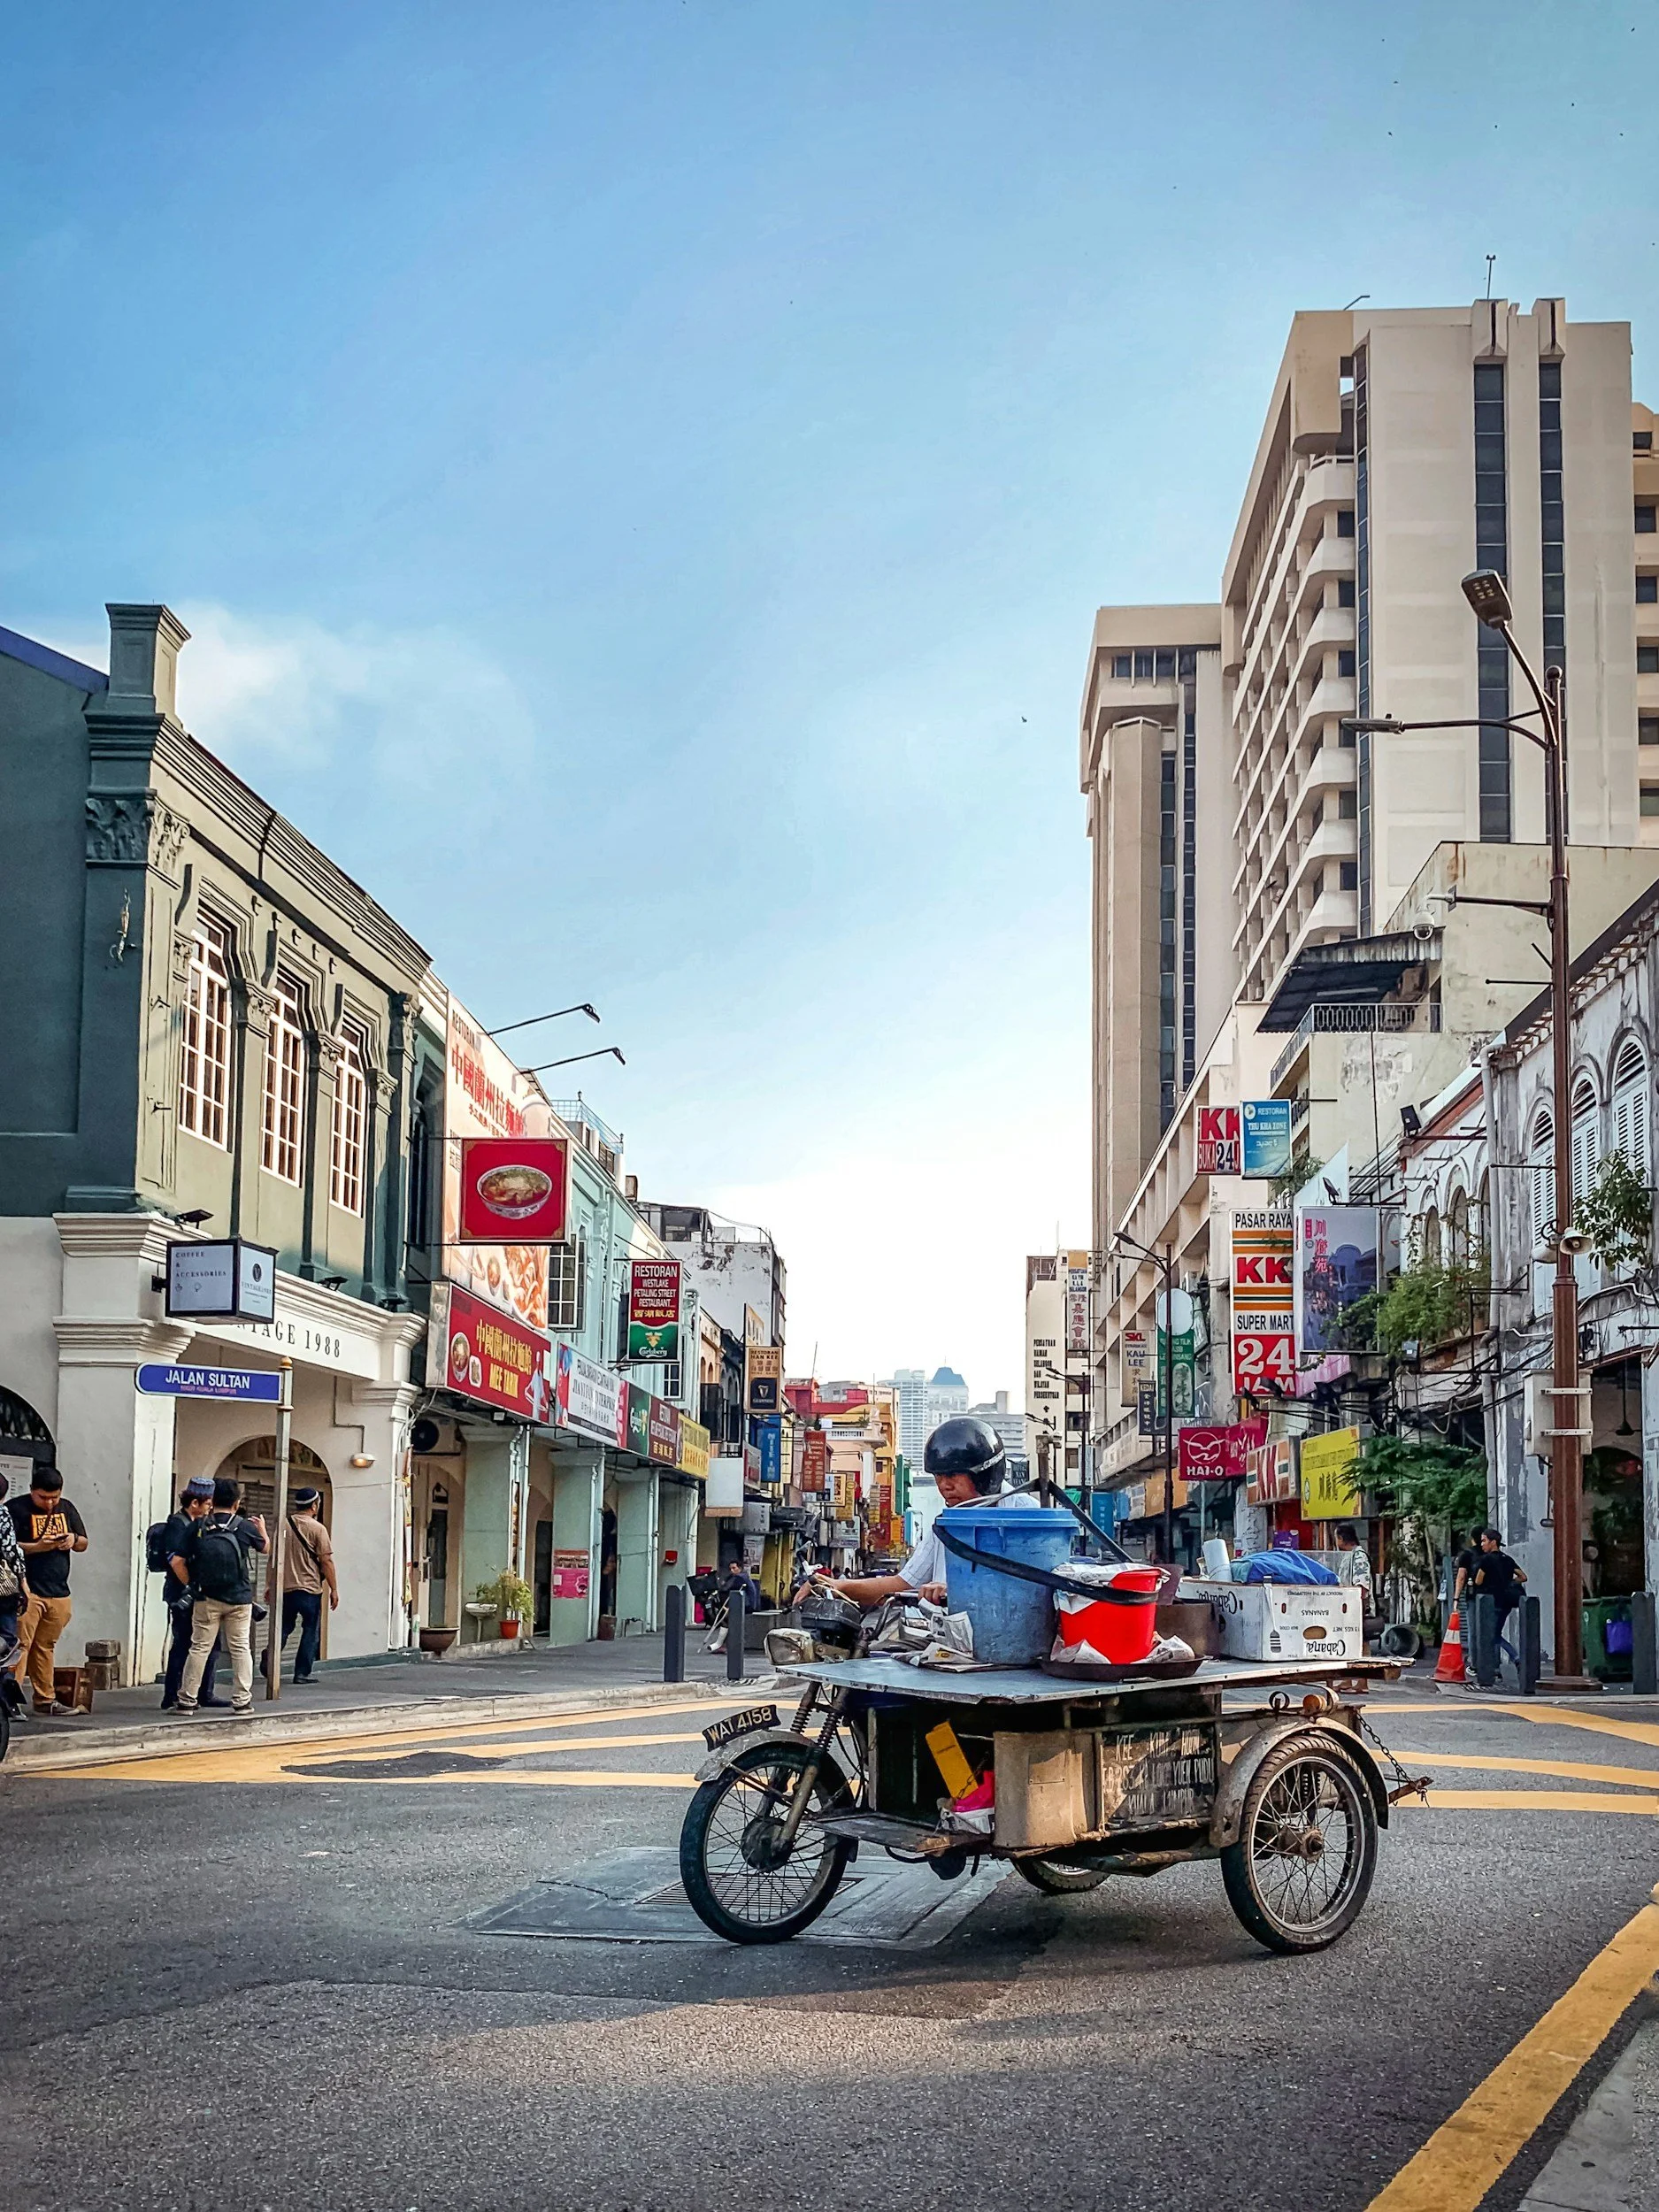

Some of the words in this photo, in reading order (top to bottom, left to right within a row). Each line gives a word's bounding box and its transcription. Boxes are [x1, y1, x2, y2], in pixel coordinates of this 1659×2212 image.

[1257, 1107, 1287, 1116] RESTORAN
[1199, 1143, 1215, 1170] BUKA
[1217, 1142, 1233, 1171] 24
[1235, 1213, 1266, 1229] PASAR
[1268, 1212, 1292, 1228] RAYA
[634, 1265, 678, 1278] RESTORAN
[1237, 1256, 1293, 1284] KK
[642, 1279, 669, 1288] WESTLAKE
[634, 1289, 657, 1298] PETALING
[658, 1289, 676, 1298] STREET
[1237, 1314, 1267, 1331] SUPER
[1269, 1314, 1294, 1330] MART
[305, 1330, 340, 1358] 1988
[639, 1346, 668, 1358] Carlsberg
[1238, 1338, 1295, 1376] 24
[165, 1369, 204, 1386] JALAN
[208, 1372, 250, 1389] SULTAN
[1306, 1639, 1346, 1657] Cabana
[708, 1718, 734, 1741] WAT
[737, 1707, 772, 1730] 4158
[1117, 1734, 1133, 1761] KEE
[1194, 1756, 1215, 1784] PUDU
